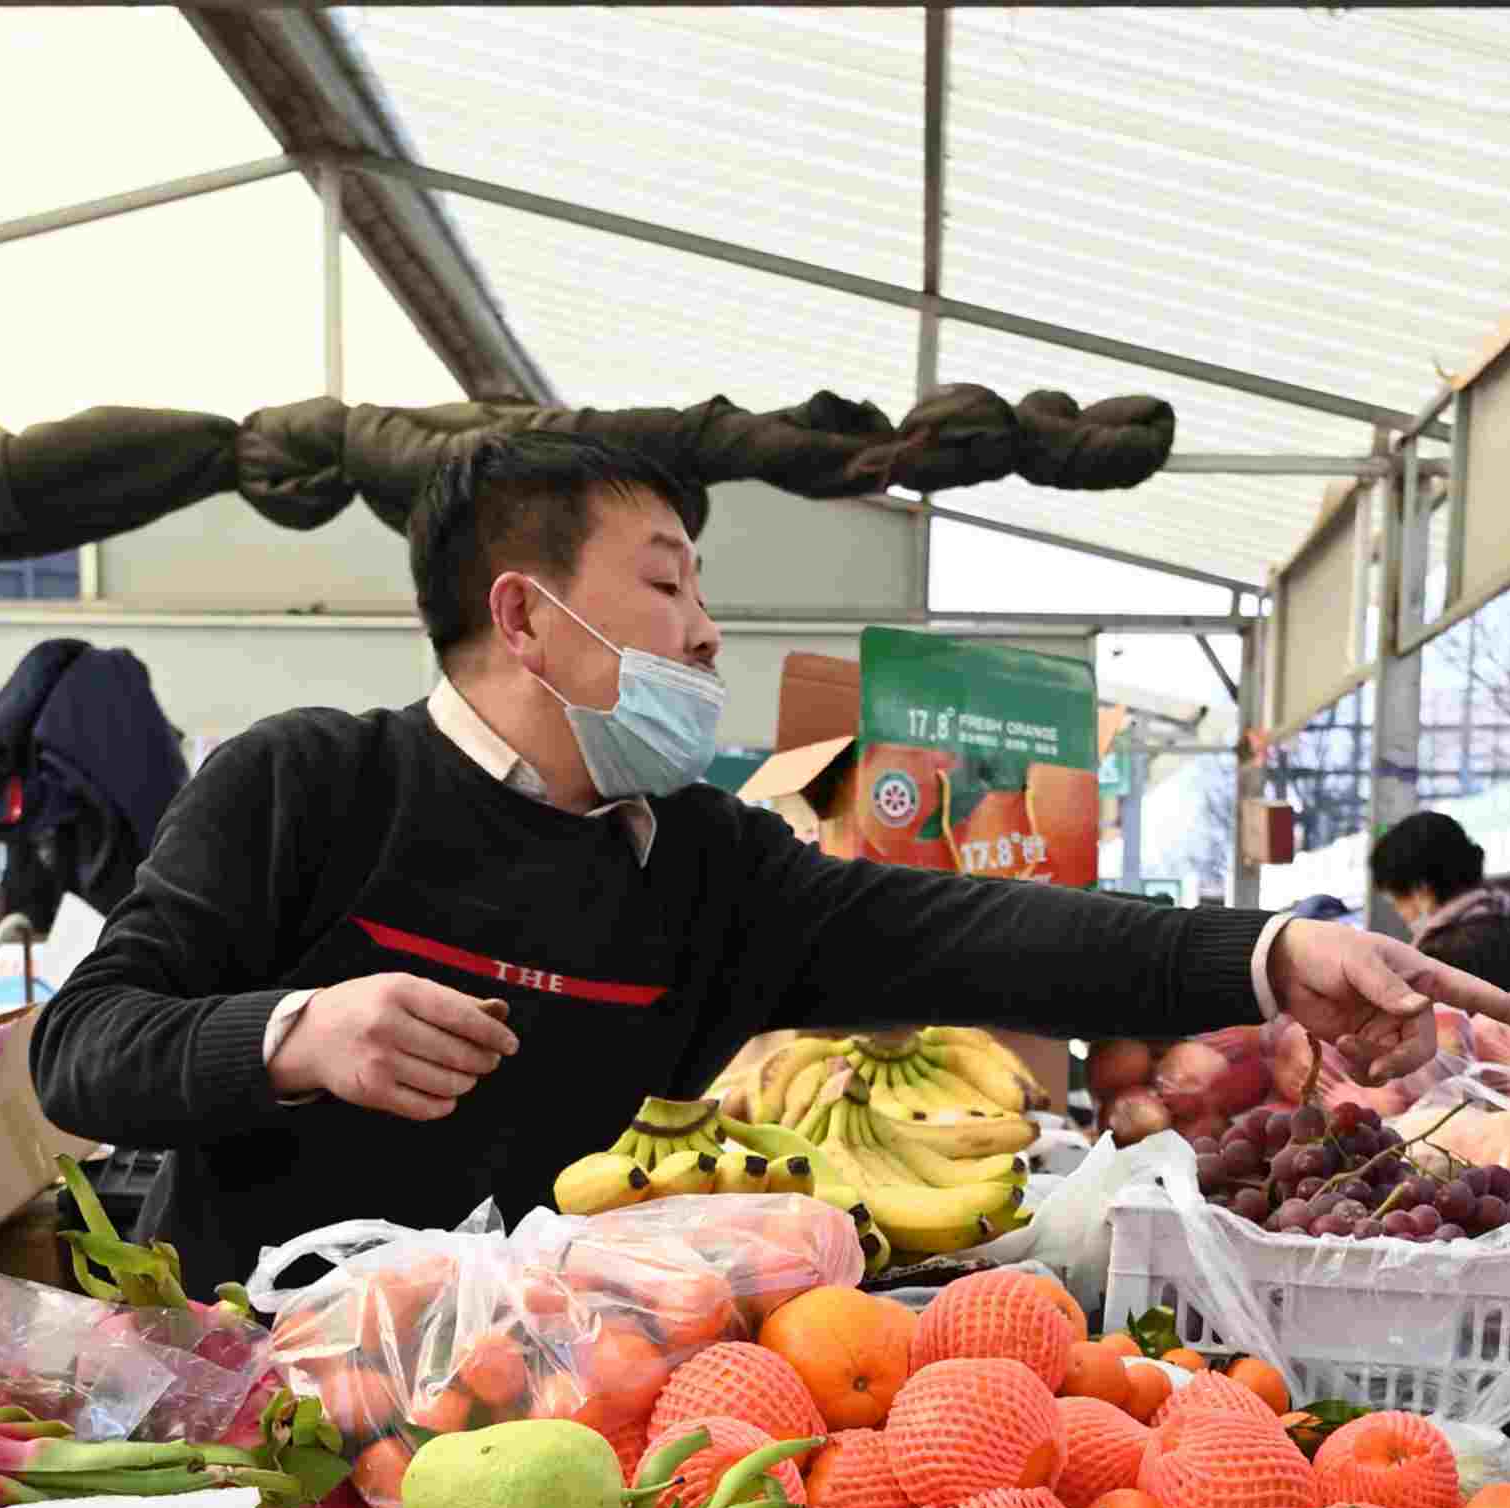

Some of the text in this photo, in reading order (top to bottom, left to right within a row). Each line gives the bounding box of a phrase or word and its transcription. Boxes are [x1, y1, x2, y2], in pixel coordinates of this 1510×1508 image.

[958, 713, 1003, 732] FRESH
[1005, 721, 1059, 741] ORANGE
[495, 960, 564, 992] THE
